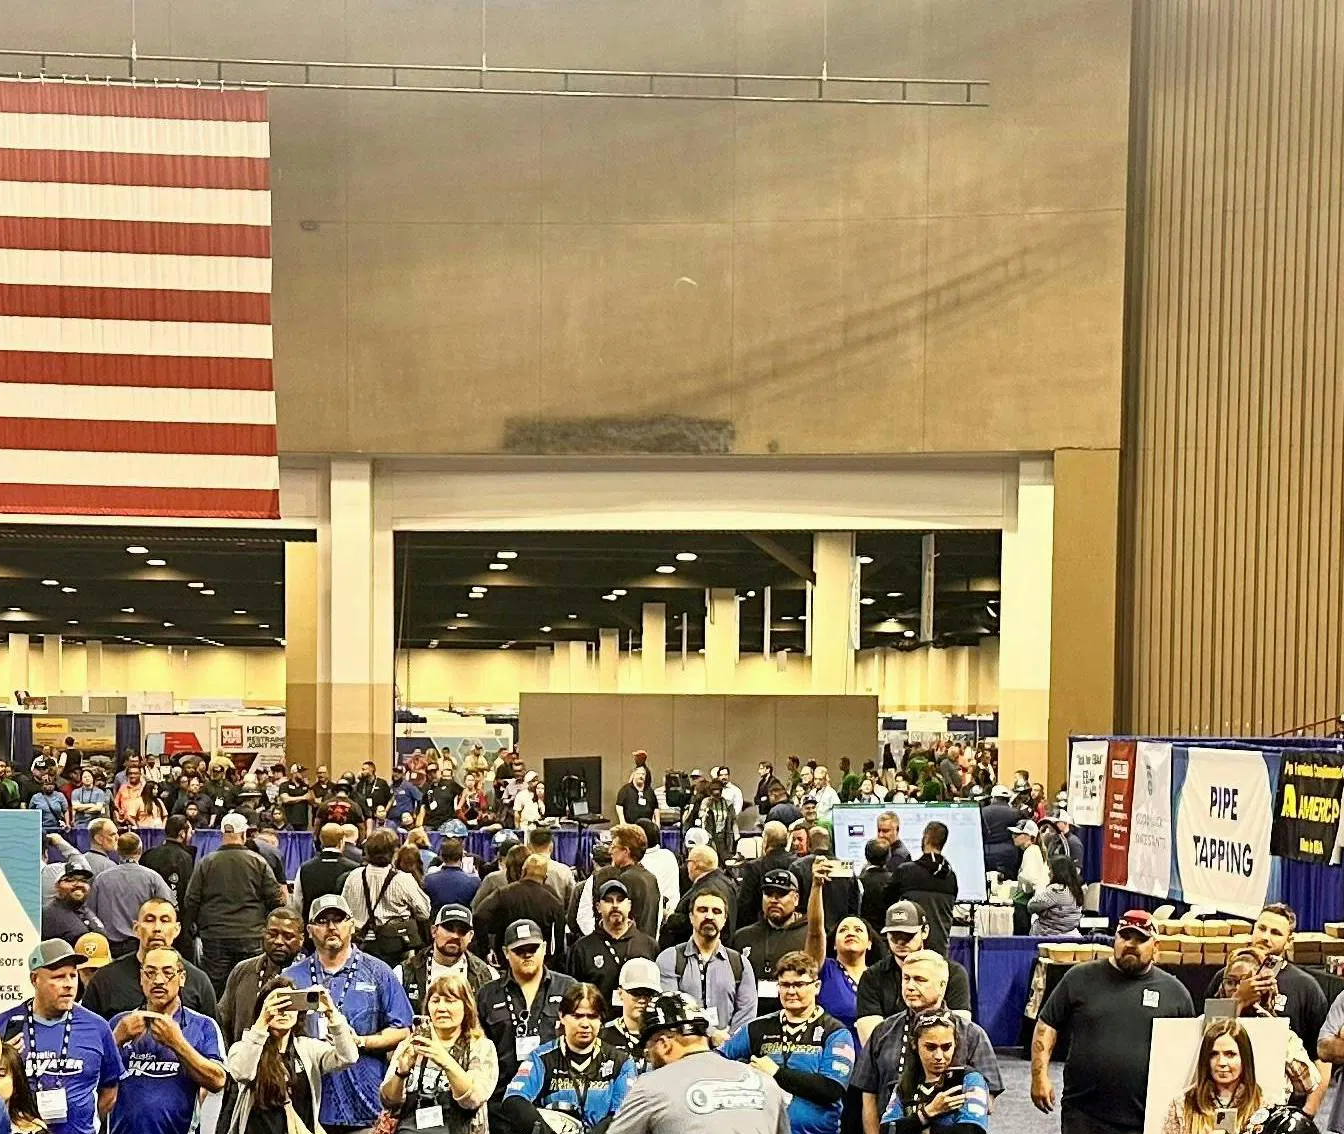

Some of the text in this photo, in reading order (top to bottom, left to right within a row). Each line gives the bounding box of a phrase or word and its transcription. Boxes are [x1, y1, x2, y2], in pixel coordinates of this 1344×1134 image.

[1209, 786, 1239, 820] PIPE
[1193, 834, 1254, 877] TAPPING
[128, 1060, 181, 1077] WATER
